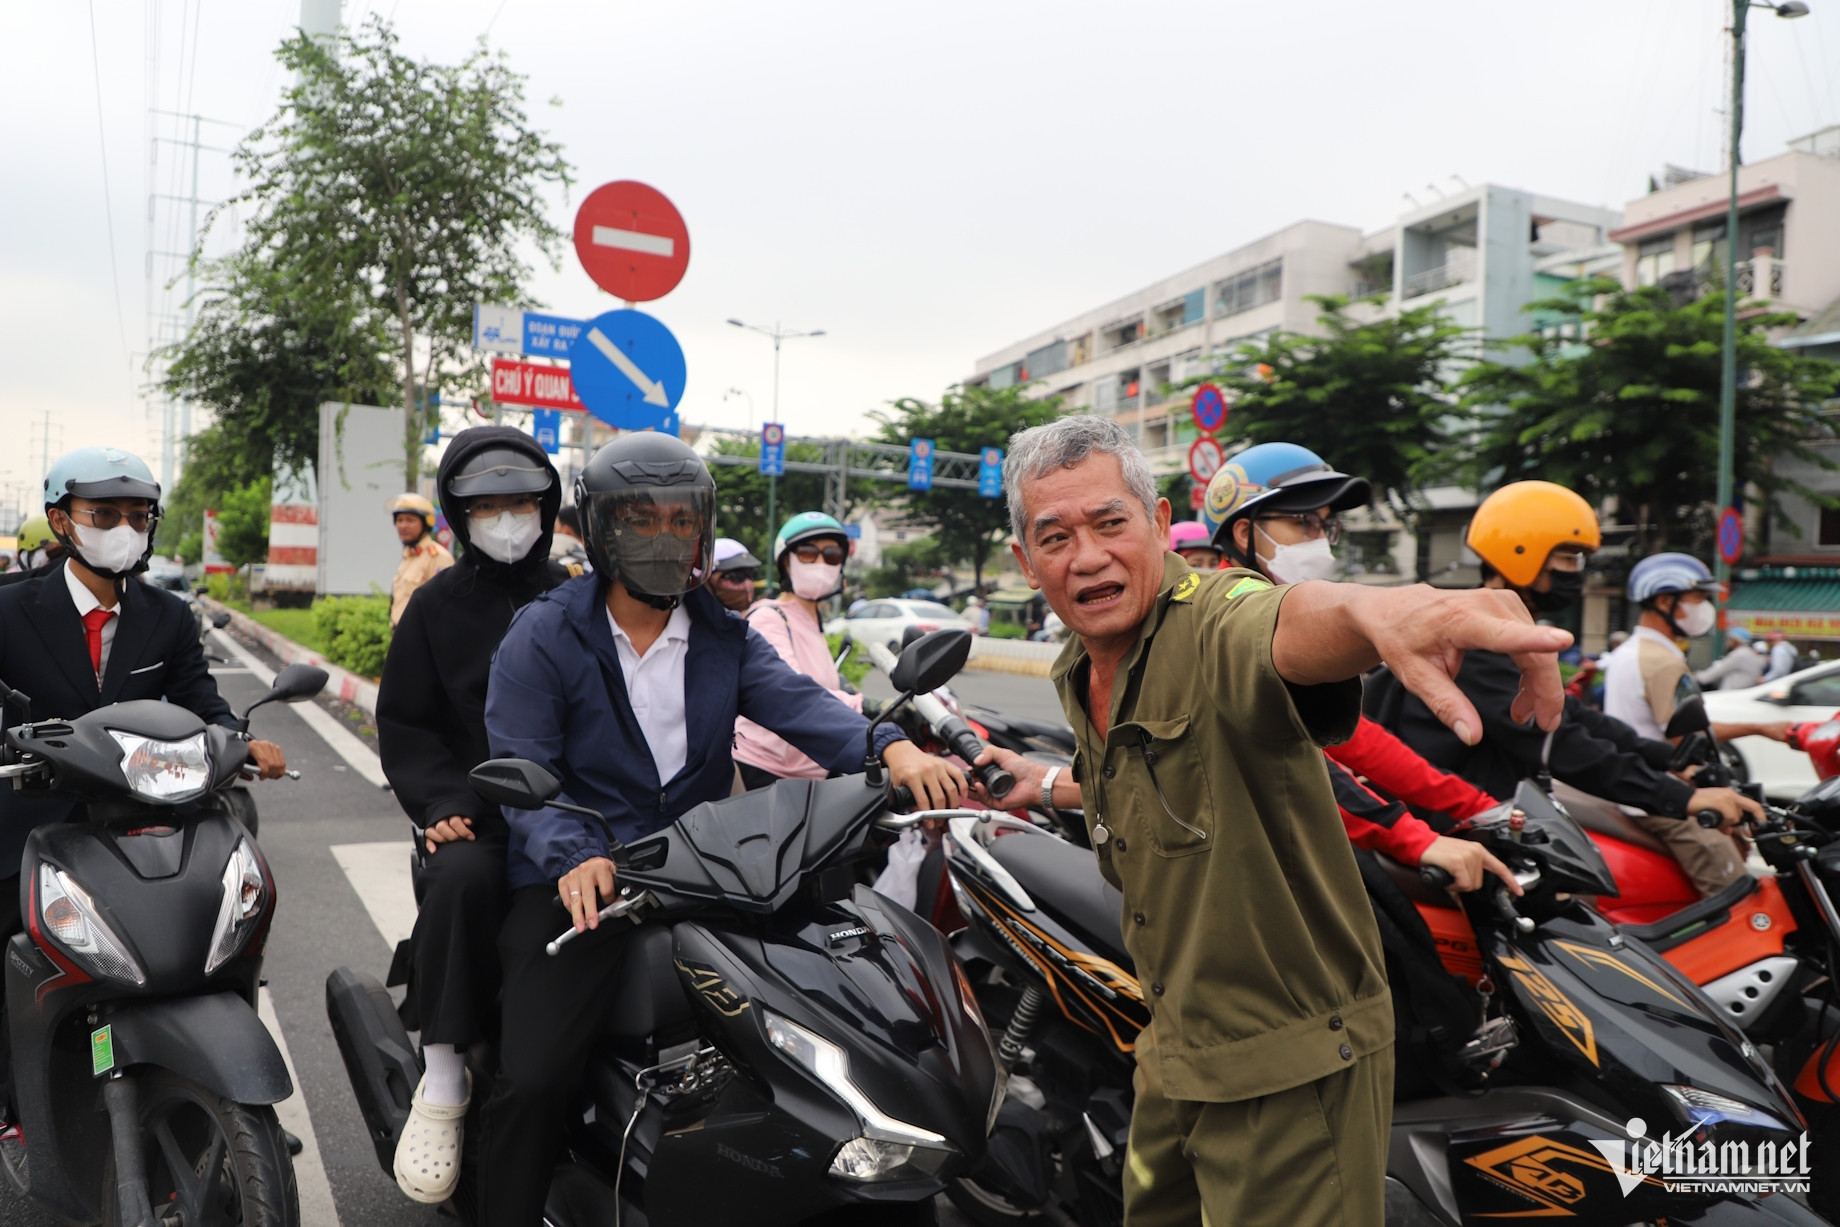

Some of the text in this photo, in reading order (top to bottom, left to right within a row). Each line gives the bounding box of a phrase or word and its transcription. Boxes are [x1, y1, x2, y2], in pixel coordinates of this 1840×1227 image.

[495, 366, 521, 396] CHÚ
[523, 367, 534, 398] Ý
[534, 373, 569, 401] QUAN
[830, 926, 870, 940] HONDA
[1496, 956, 1583, 1029] 125
[717, 1142, 785, 1178] HONDA
